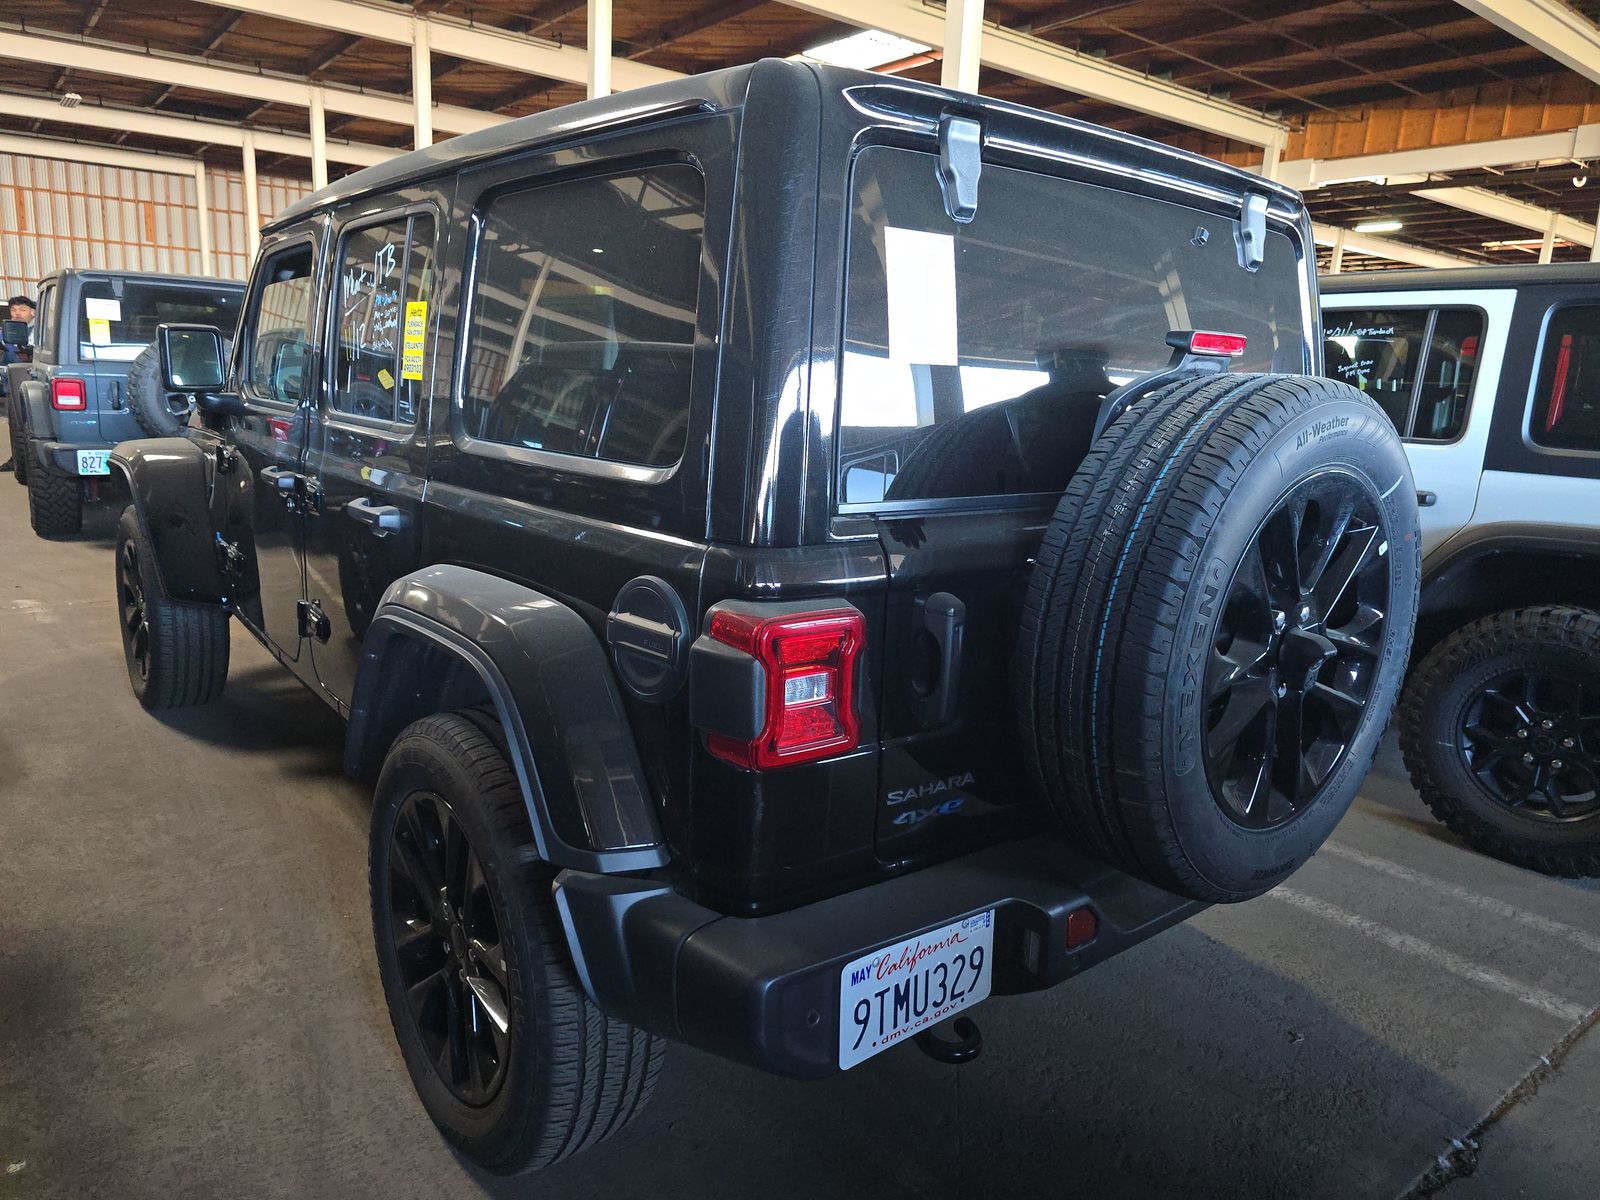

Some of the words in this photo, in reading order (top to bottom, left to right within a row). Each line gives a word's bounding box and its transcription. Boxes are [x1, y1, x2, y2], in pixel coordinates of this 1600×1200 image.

[1296, 415, 1350, 451] All-Weather
[1318, 429, 1349, 444] Performance
[643, 639, 665, 652] FUEL
[1178, 583, 1220, 753] NEXEN
[886, 772, 976, 806] SAHARA
[851, 966, 873, 987] MAY
[876, 931, 968, 981] California
[853, 945, 985, 1051] 9TMU329
[881, 1002, 958, 1044] dmv.ca.gov
